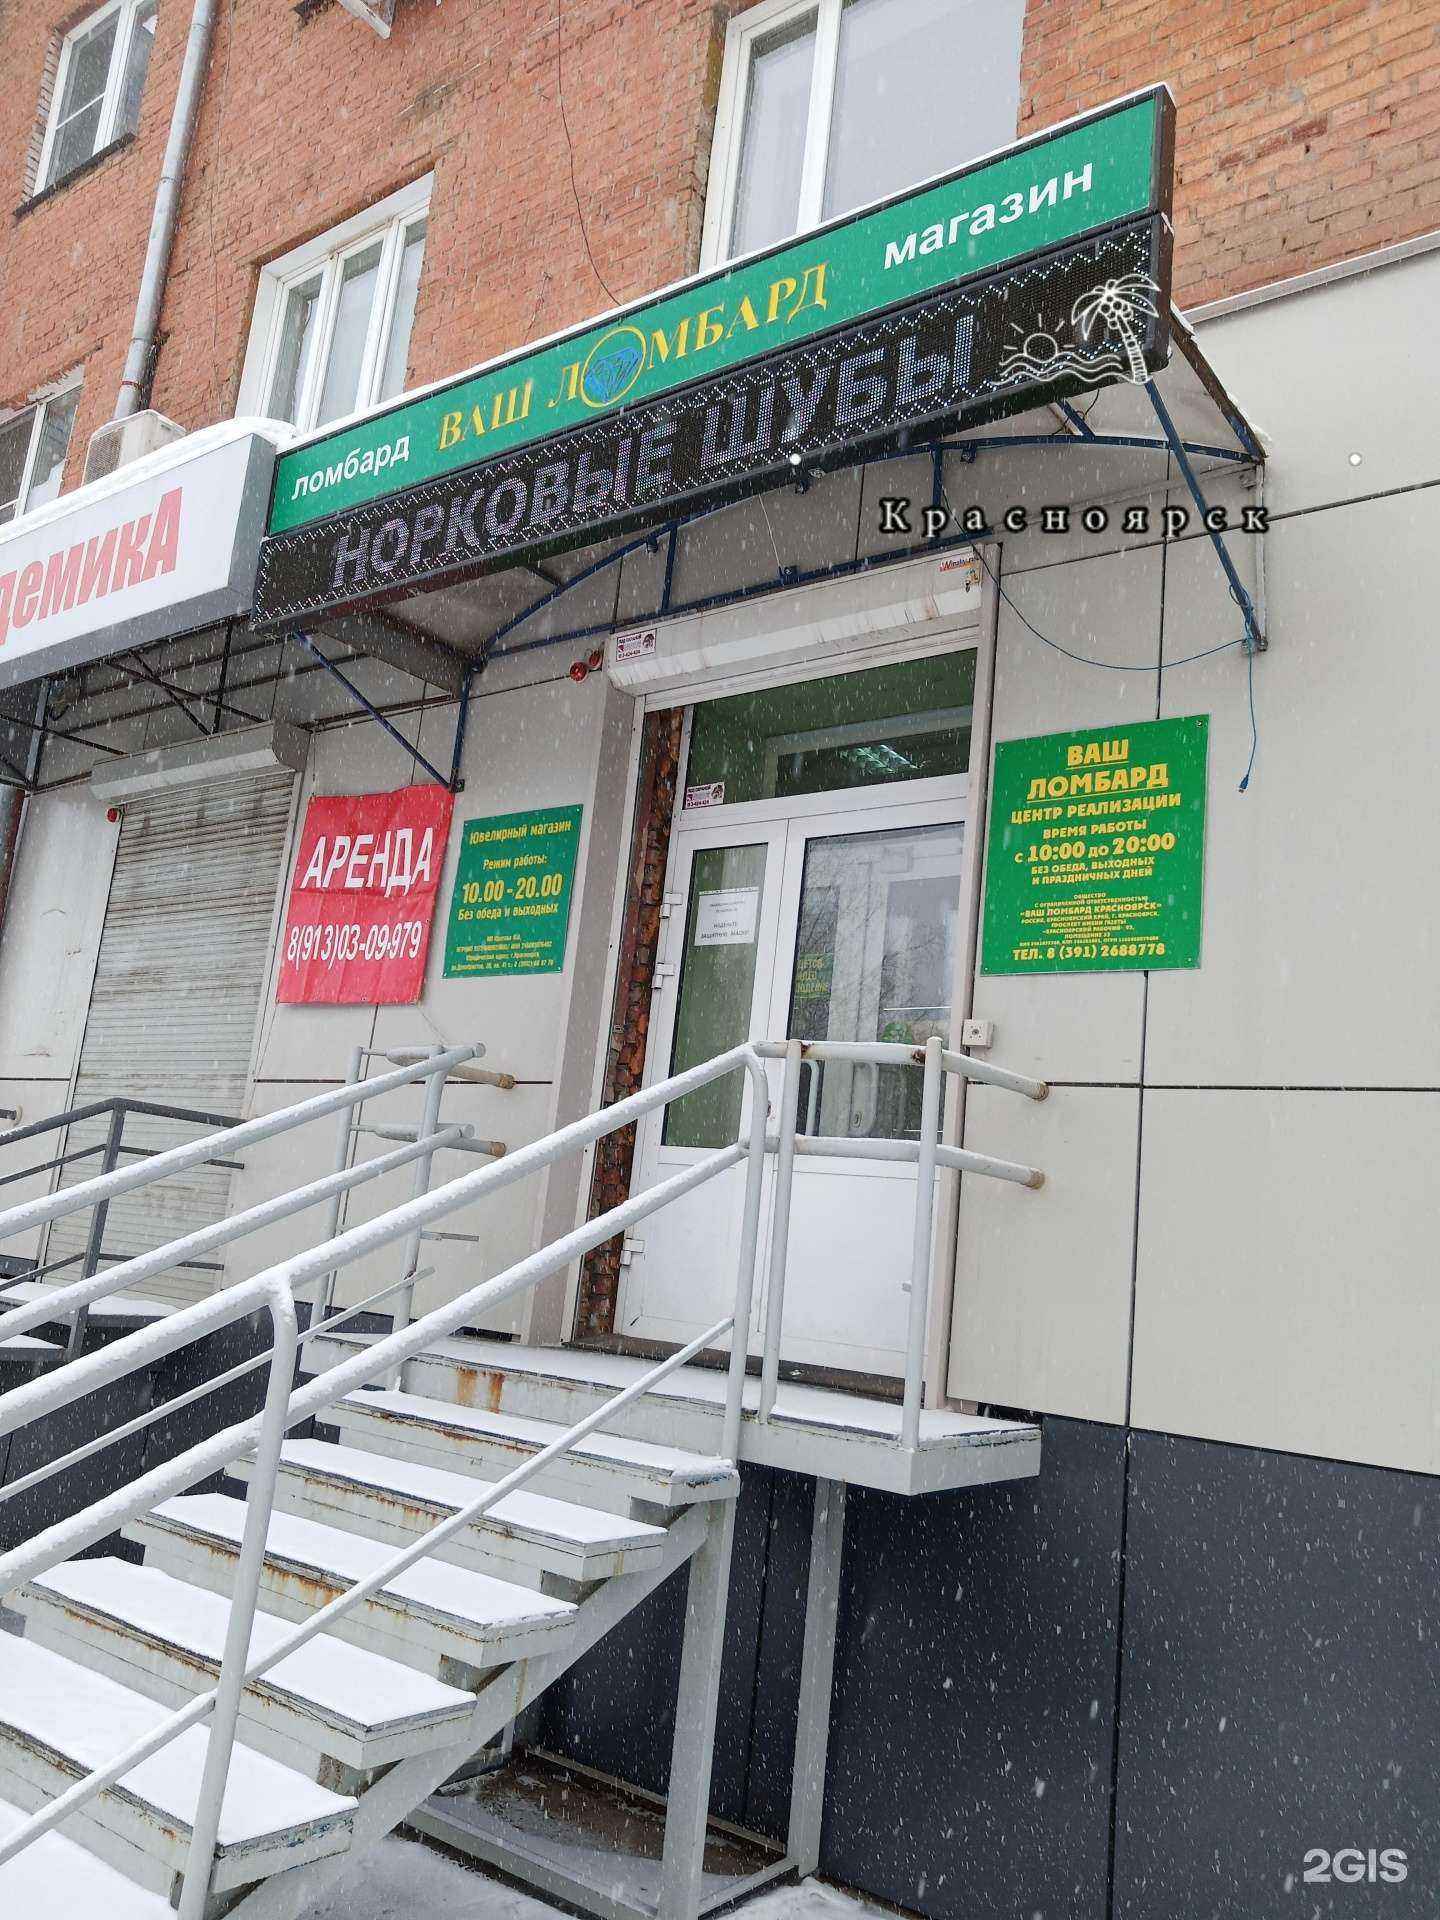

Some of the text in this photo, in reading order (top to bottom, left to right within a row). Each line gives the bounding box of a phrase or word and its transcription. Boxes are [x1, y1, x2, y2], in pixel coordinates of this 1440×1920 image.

[291, 162, 1094, 501] ломбард ВАШ ЛОМБАРД магазин
[329, 314, 974, 591] НОРКОВЫЕ ШУБЫ
[1067, 739, 1129, 767] ВАШ
[1026, 763, 1169, 801] ЛОМБАРД
[1011, 792, 1182, 824] ЦЕНТР РЕАЛИЗАЦИИ
[469, 820, 572, 845] Ювелирный магазин
[1043, 819, 1147, 839] ВРЕМЯ РАБОТЫ
[1028, 841, 1086, 862] 10:00
[1112, 832, 1176, 855] 20:00
[299, 827, 434, 899] АРЕНДА
[482, 854, 548, 870] Режим работы:
[1031, 864, 1049, 875] БЕЗ
[1091, 856, 1156, 870] ВЫХОДНЫХ
[1032, 866, 1153, 885] И ПРАЗДНИЧНЫХ ДНЕЙ
[457, 908, 474, 920] Без
[476, 907, 501, 920] обеда
[513, 903, 559, 918] выходных
[1047, 906, 1092, 917] ЛОМБАРД
[1012, 948, 1043, 961] ТЕЛ.
[1046, 947, 1055, 959] 8
[1058, 944, 1098, 960] (391)
